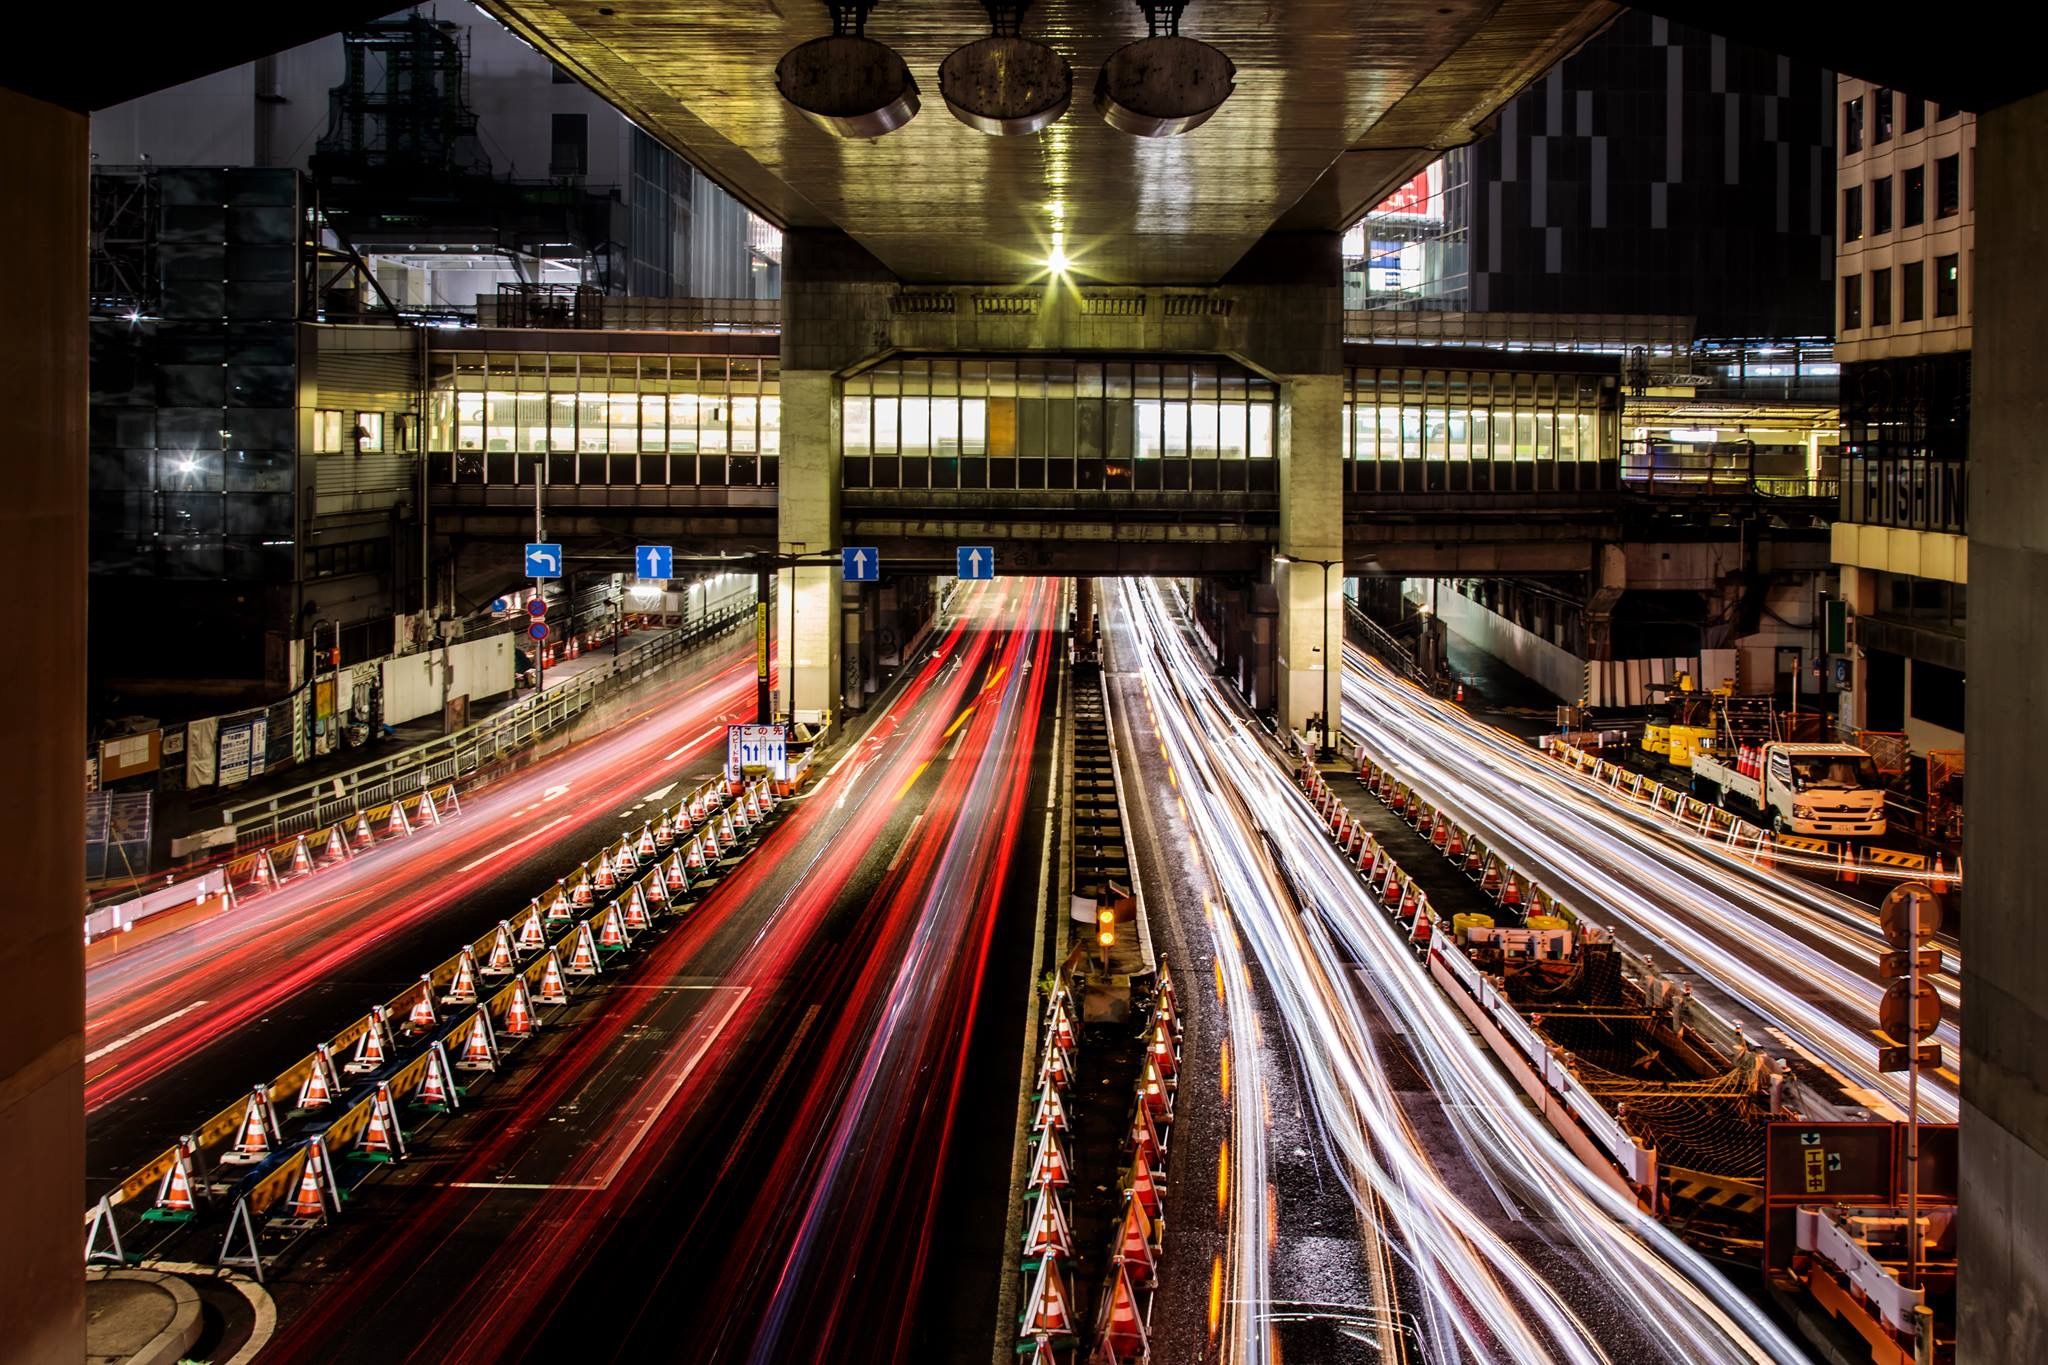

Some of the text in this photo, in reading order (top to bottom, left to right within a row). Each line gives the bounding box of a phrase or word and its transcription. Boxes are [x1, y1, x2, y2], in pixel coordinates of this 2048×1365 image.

[1868, 465, 1969, 527] FISHIN
[743, 725, 783, 736] この先
[1807, 1151, 1823, 1190] 工事中
